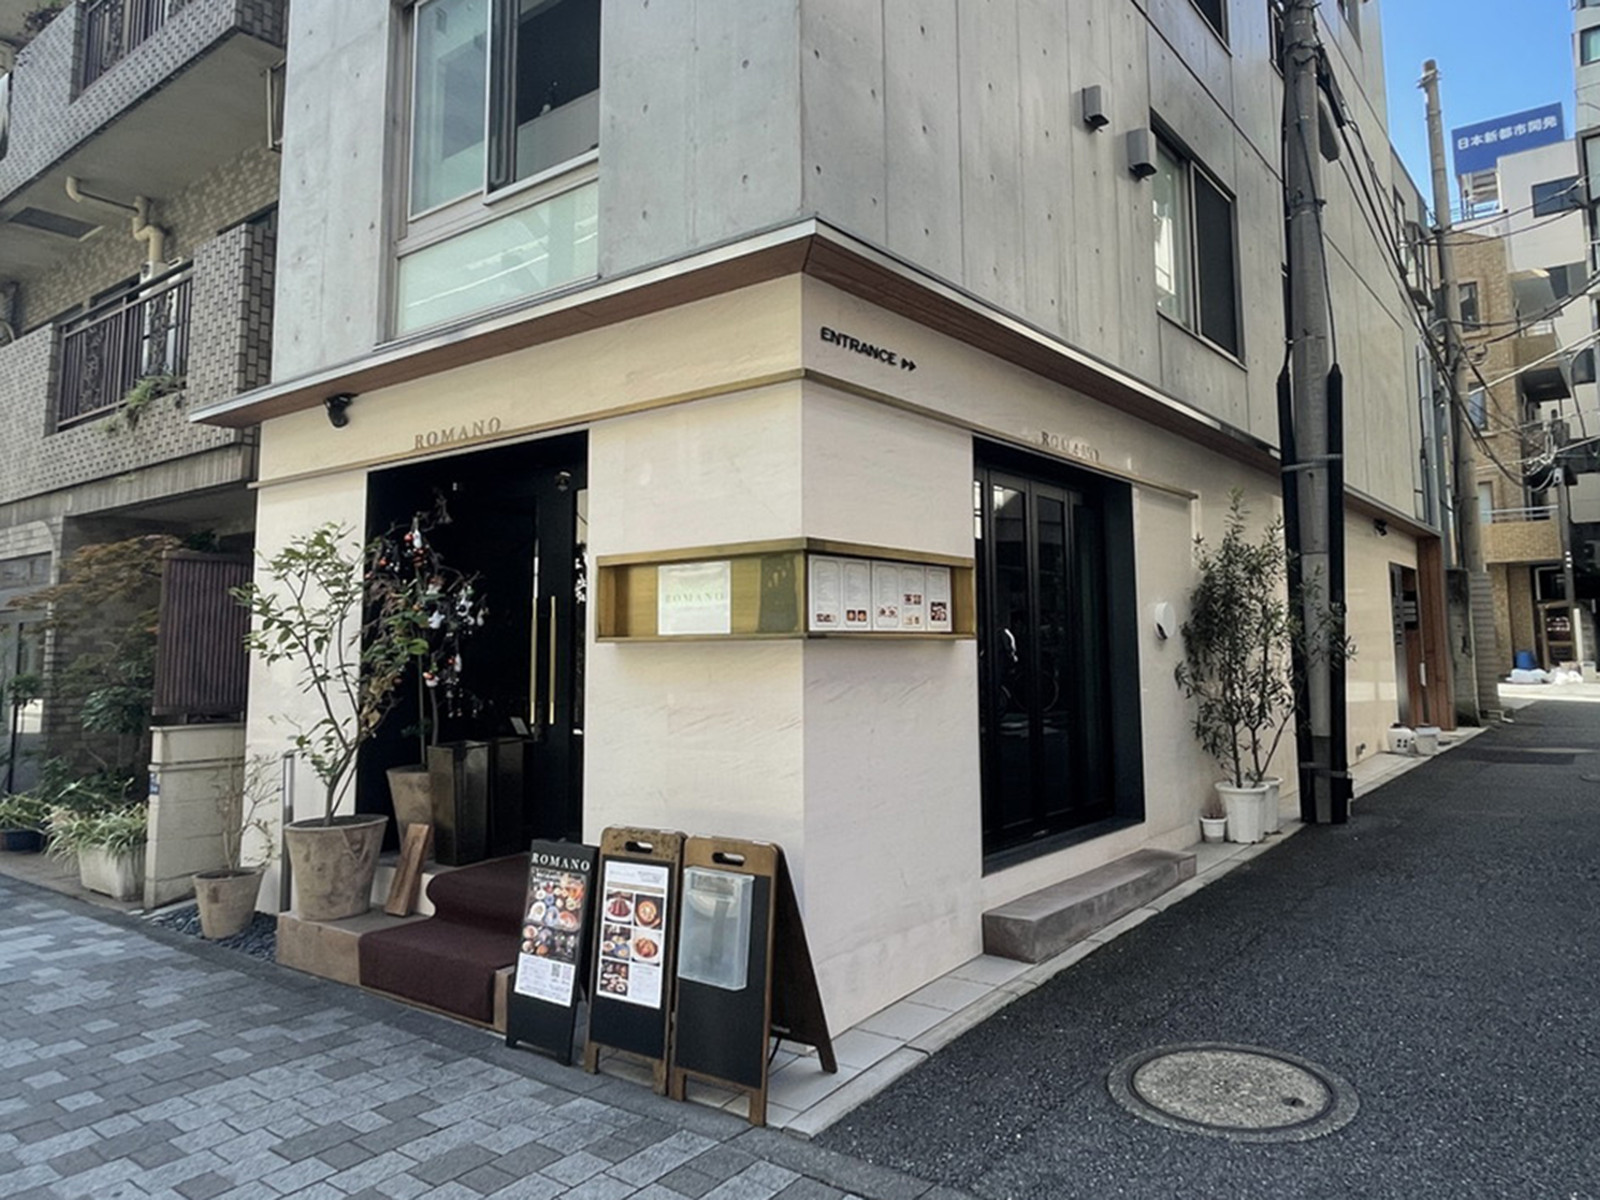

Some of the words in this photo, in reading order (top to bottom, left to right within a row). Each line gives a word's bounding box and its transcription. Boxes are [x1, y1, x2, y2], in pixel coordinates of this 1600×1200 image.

[1457, 116, 1557, 150] 日本新都市開発
[821, 327, 897, 366] ENTRANCE
[414, 417, 501, 448] ROMANO
[531, 853, 591, 872] ROMANO
